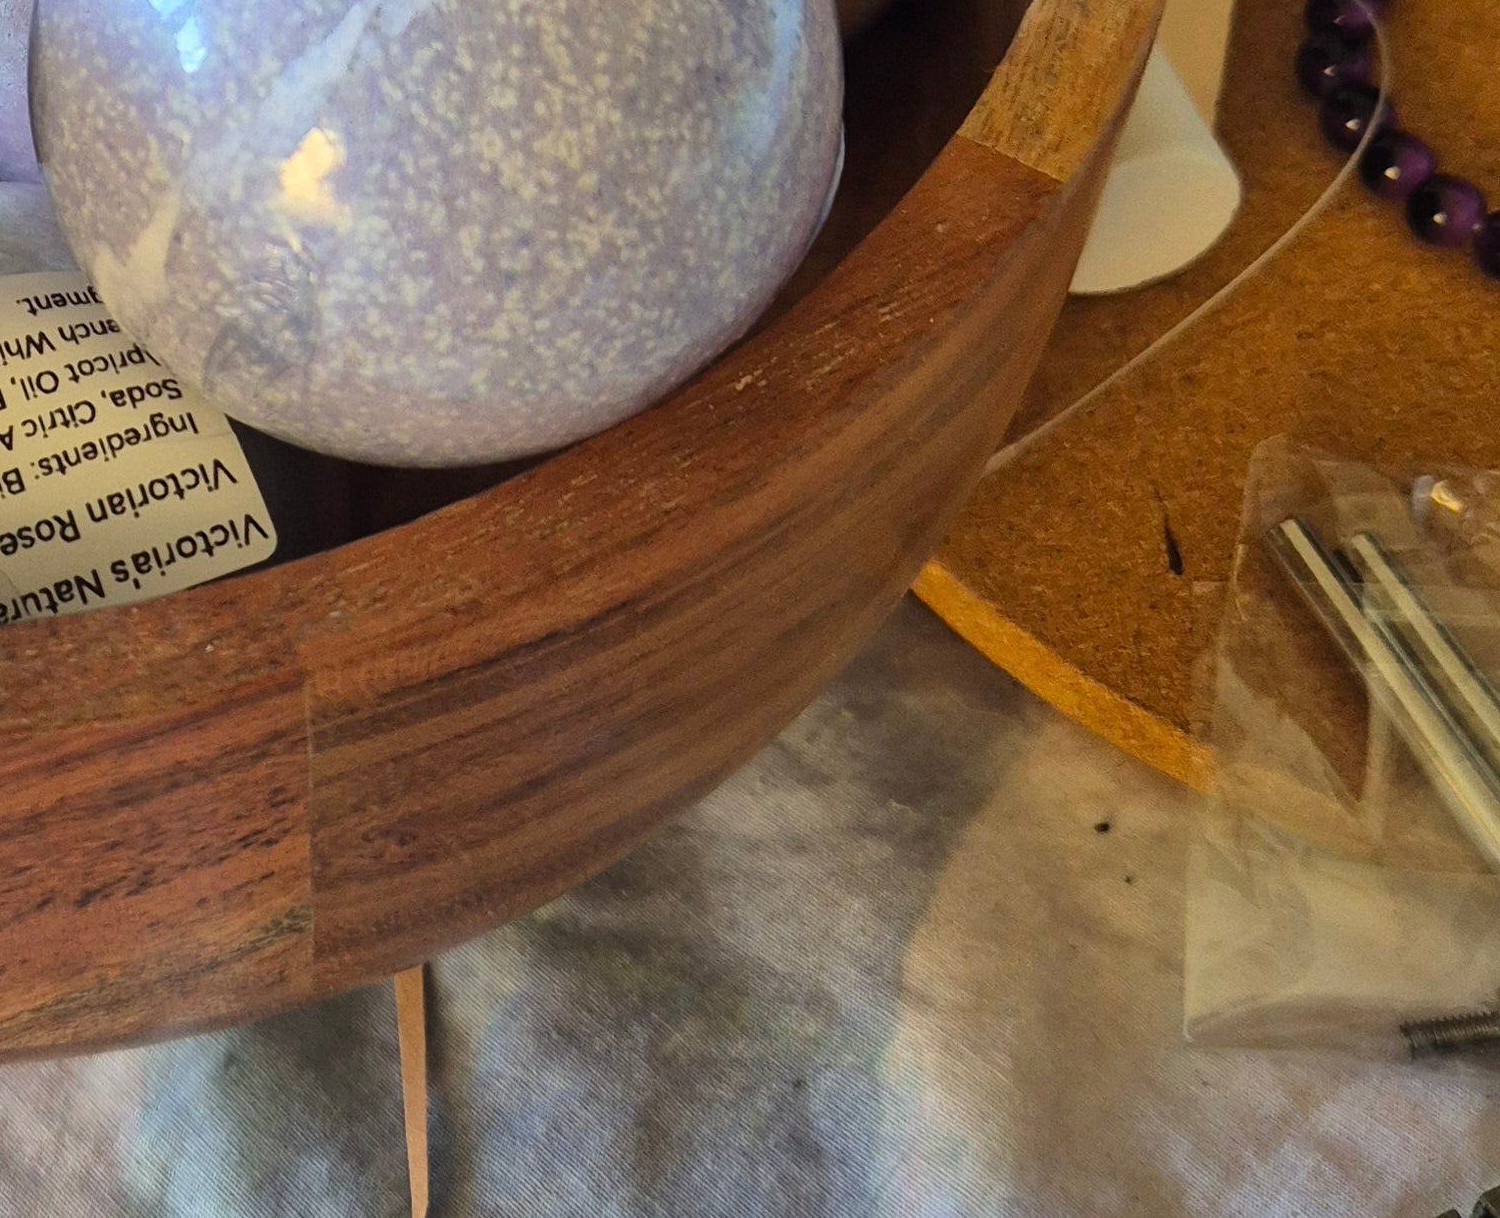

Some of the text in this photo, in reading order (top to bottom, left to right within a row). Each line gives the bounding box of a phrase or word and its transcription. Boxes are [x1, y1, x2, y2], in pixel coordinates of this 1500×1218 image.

[58, 319, 120, 345] ench
[10, 371, 59, 399] Oil,
[101, 379, 182, 408] Soda,
[21, 400, 95, 438] Citric
[30, 413, 198, 479] Ingredients:
[86, 459, 237, 524] Victorian
[0, 510, 80, 556] Rose
[111, 514, 269, 589] Victoria's
